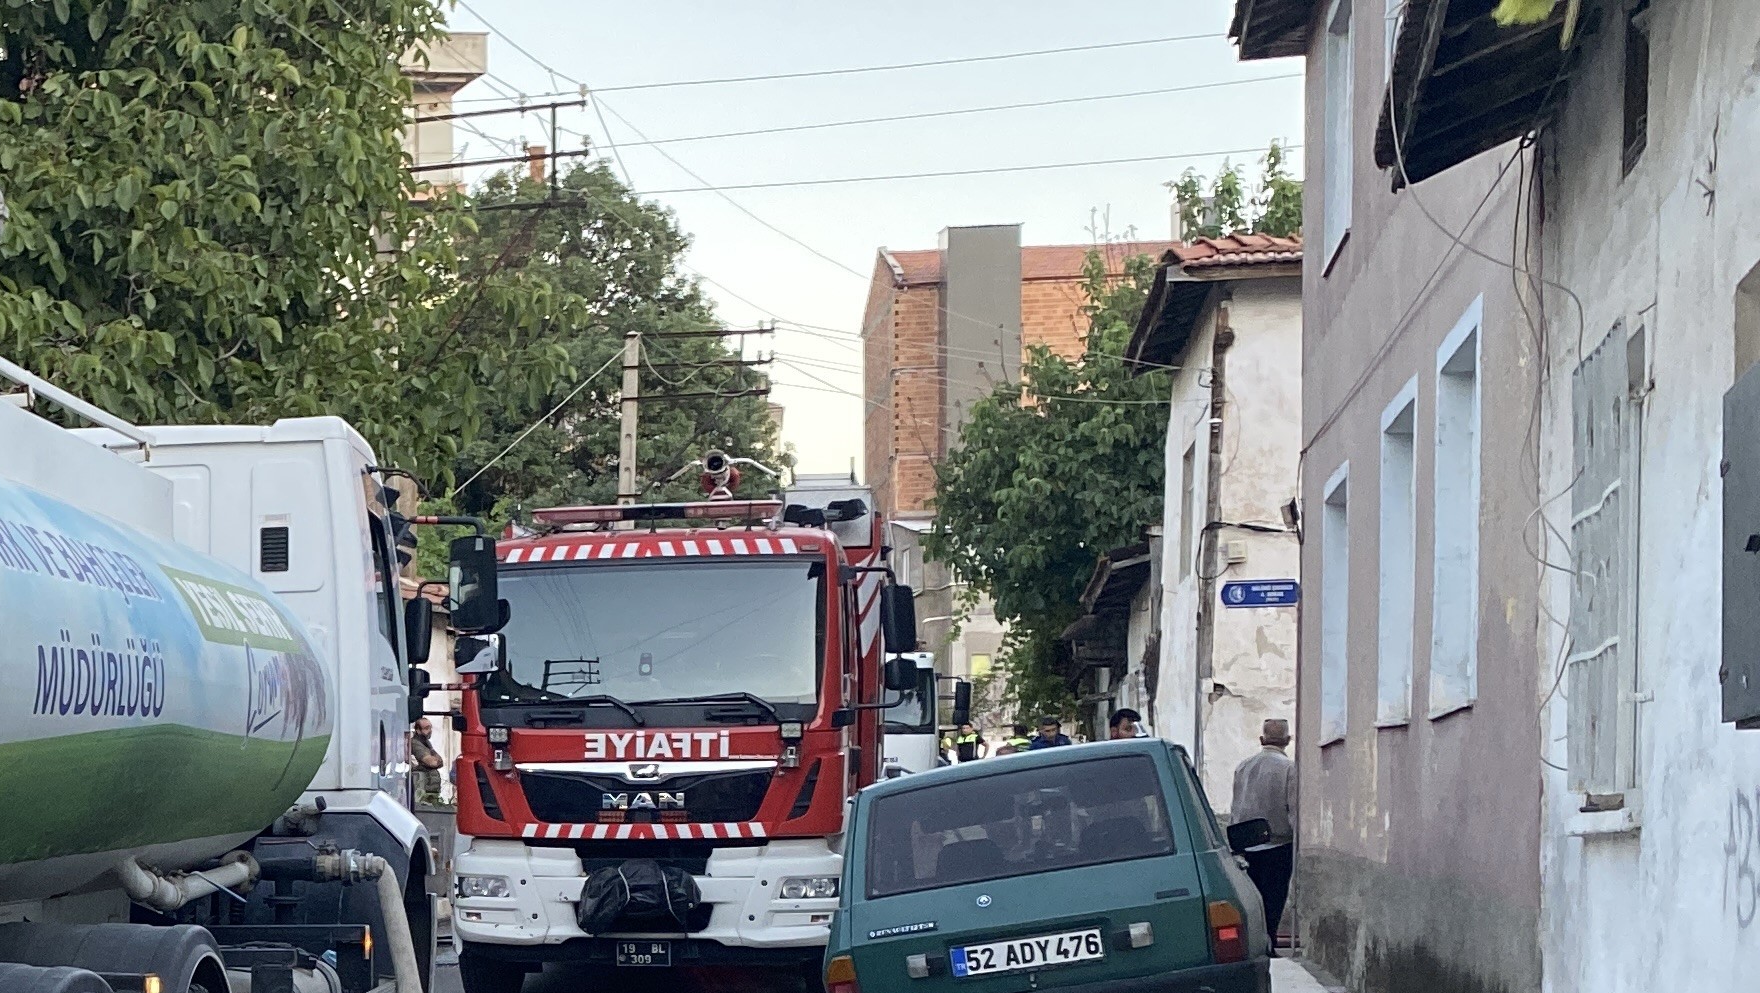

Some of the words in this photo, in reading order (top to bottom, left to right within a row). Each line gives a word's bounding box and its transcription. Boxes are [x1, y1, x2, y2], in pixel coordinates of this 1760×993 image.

[9, 520, 70, 580] VE
[33, 628, 165, 718] MÜDÜRLÜĞÜ
[602, 792, 685, 810] MAN
[622, 943, 636, 954] 19
[651, 943, 666, 954] BL
[630, 954, 652, 964] 309
[966, 947, 997, 972] 52
[1006, 939, 1050, 967] ADY
[1056, 933, 1100, 959] 476
